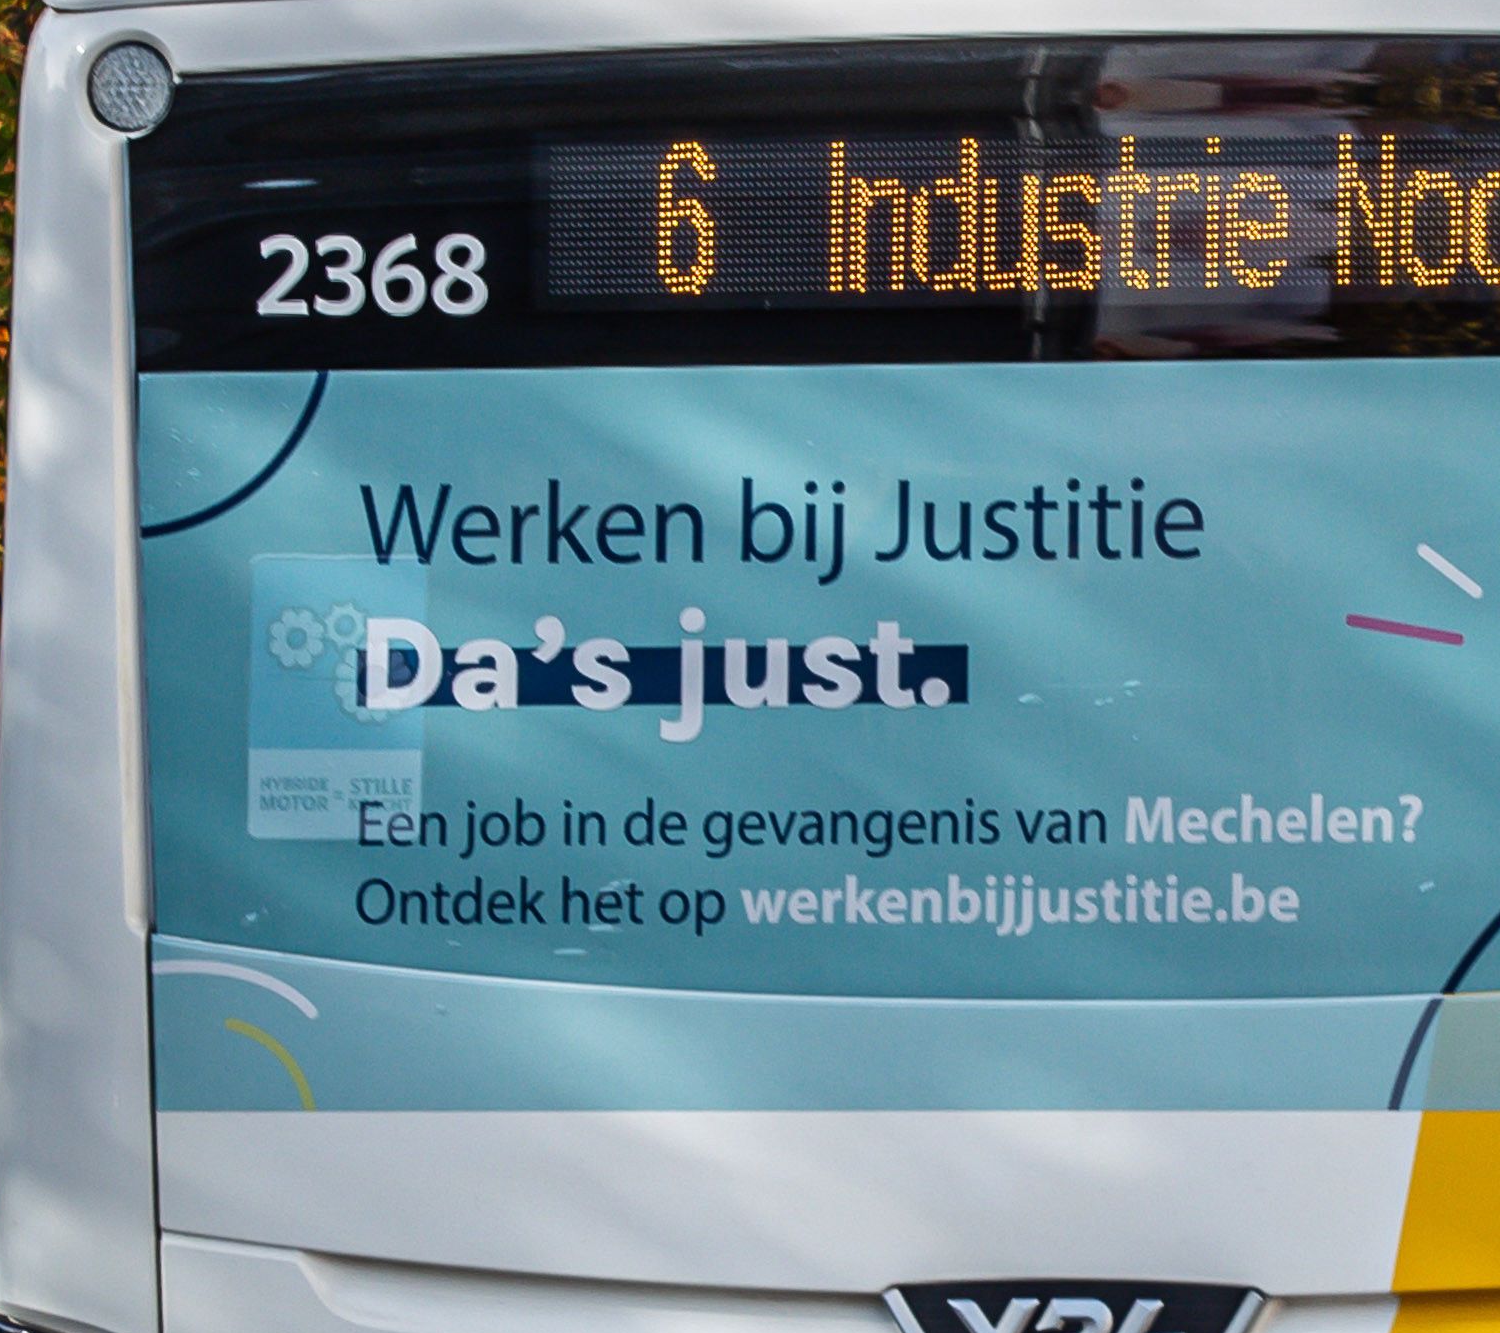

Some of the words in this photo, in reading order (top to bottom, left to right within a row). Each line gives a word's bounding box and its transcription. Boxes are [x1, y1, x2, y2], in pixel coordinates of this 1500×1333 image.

[658, 141, 716, 295] 6
[830, 136, 1290, 293] Industrie
[256, 232, 489, 317] 2368
[361, 478, 703, 564] Werken
[740, 477, 846, 585] bij
[875, 476, 1205, 562] Justitie
[660, 607, 953, 743] just.
[259, 794, 329, 811] MOTOR
[358, 800, 447, 847] Een
[459, 798, 546, 859] job
[562, 798, 606, 846] in
[623, 797, 688, 847] de
[703, 797, 1000, 859] gevangenis
[1018, 807, 1108, 846] van
[1125, 794, 1424, 846] Mechelen?
[356, 876, 545, 925] Ontdek
[561, 876, 645, 925] het
[658, 886, 727, 936] op
[741, 874, 1300, 937] werkenbijjustitie.be
